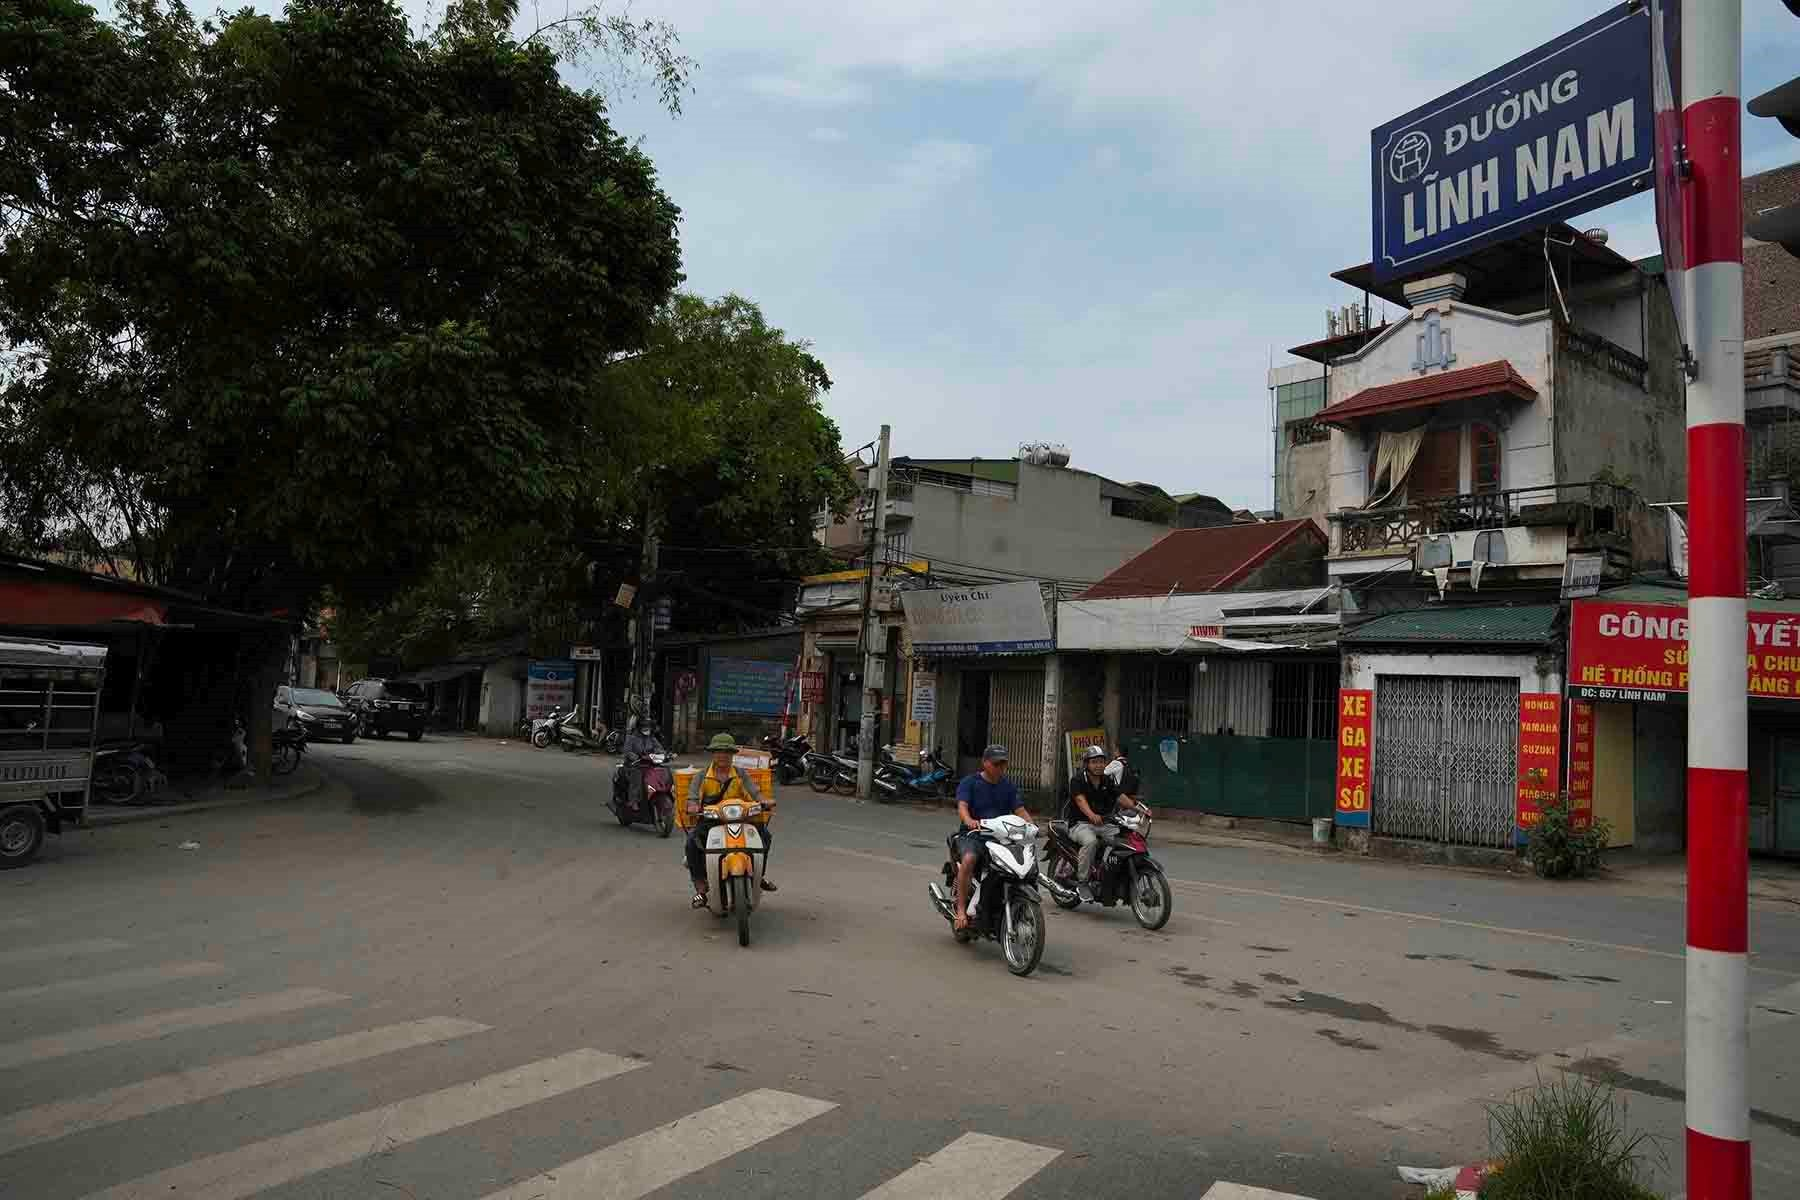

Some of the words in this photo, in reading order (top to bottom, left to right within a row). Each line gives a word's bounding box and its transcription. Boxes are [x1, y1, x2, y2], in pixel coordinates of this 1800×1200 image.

[1444, 70, 1579, 155] ĐƯỜNG
[1403, 158, 1499, 244] LĨNH
[1516, 98, 1635, 201] NAM
[1599, 611, 1688, 640] CÔNG
[1582, 664, 1606, 685] HỆ
[1612, 664, 1672, 686] THỐNG
[1746, 673, 1791, 693] ĂNG
[1525, 700, 1555, 711] HONDA
[1599, 689, 1617, 699] 657
[1619, 689, 1641, 700] LĨNH
[1643, 691, 1666, 701] NAM
[1343, 696, 1366, 716] XE
[1342, 726, 1366, 747] GA
[1521, 721, 1558, 733] YAMAHA
[1522, 744, 1555, 755] SUZUKI
[1341, 757, 1365, 778] XE
[1340, 780, 1366, 809] SỐ
